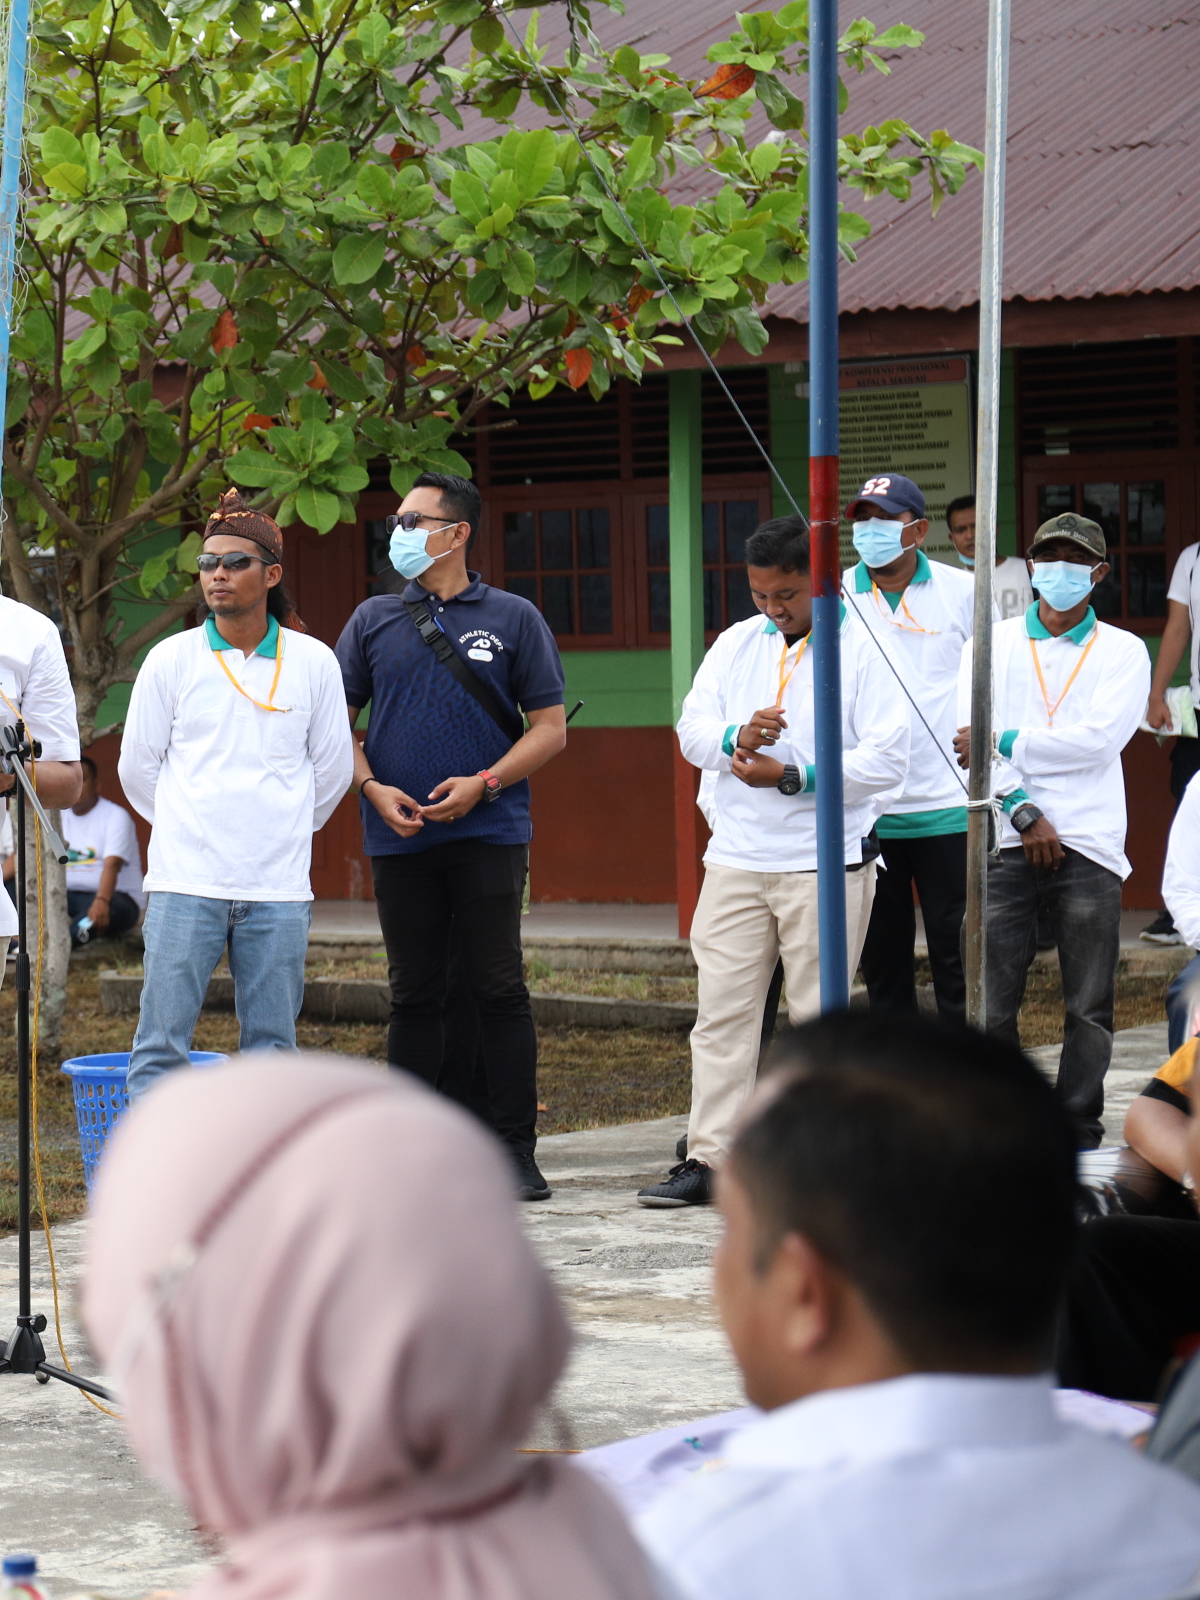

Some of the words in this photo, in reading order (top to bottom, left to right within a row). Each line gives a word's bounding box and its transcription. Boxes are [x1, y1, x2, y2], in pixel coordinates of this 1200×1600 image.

[861, 477, 891, 496] 52
[1042, 529, 1071, 540] Mercedes
[459, 630, 490, 645] ATHLETIC
[489, 634, 504, 652] DEPT.
